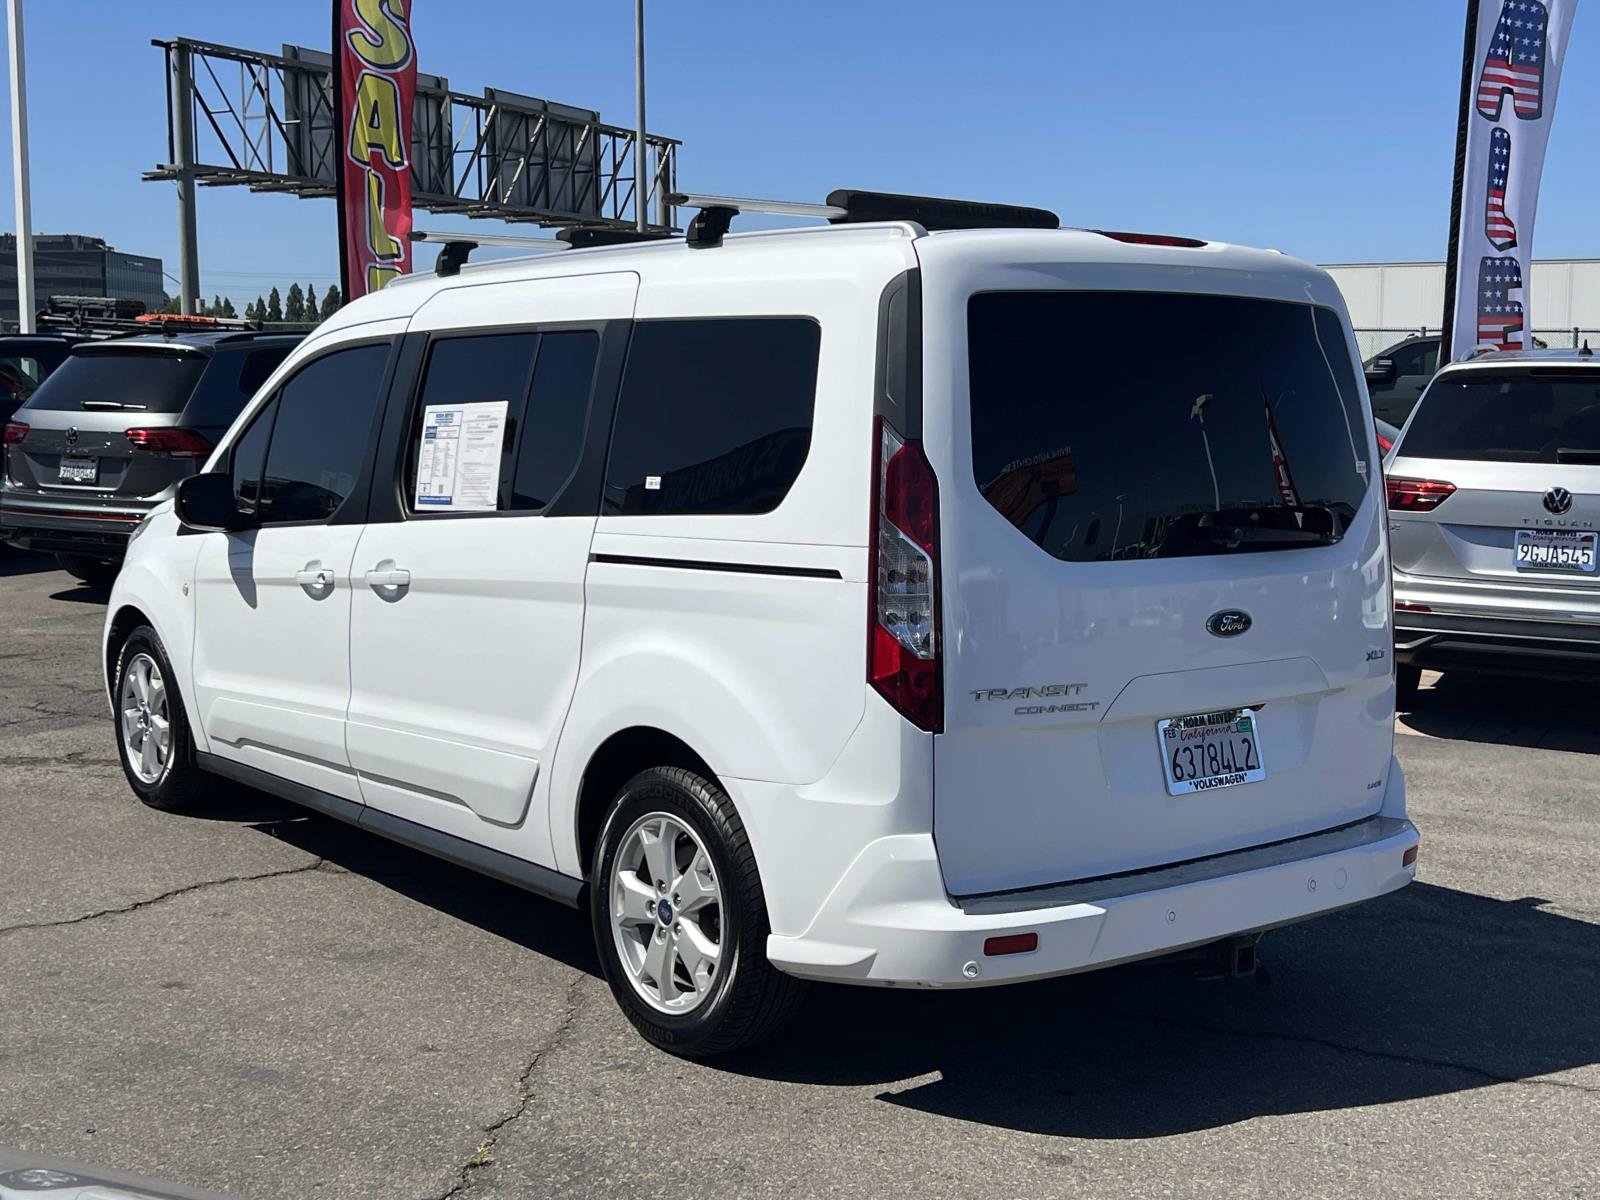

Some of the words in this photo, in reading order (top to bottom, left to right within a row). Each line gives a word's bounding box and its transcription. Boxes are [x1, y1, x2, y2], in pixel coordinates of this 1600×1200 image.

[1522, 518, 1593, 528] TIGUAN
[1520, 543, 1591, 565] 9GJA545
[1220, 615, 1245, 631] Ford
[968, 683, 1088, 701] TRANSIT
[1014, 702, 1100, 716] CONNECT
[1183, 715, 1206, 729] NORM
[1181, 725, 1234, 743] California
[1172, 738, 1256, 780] 63784L2
